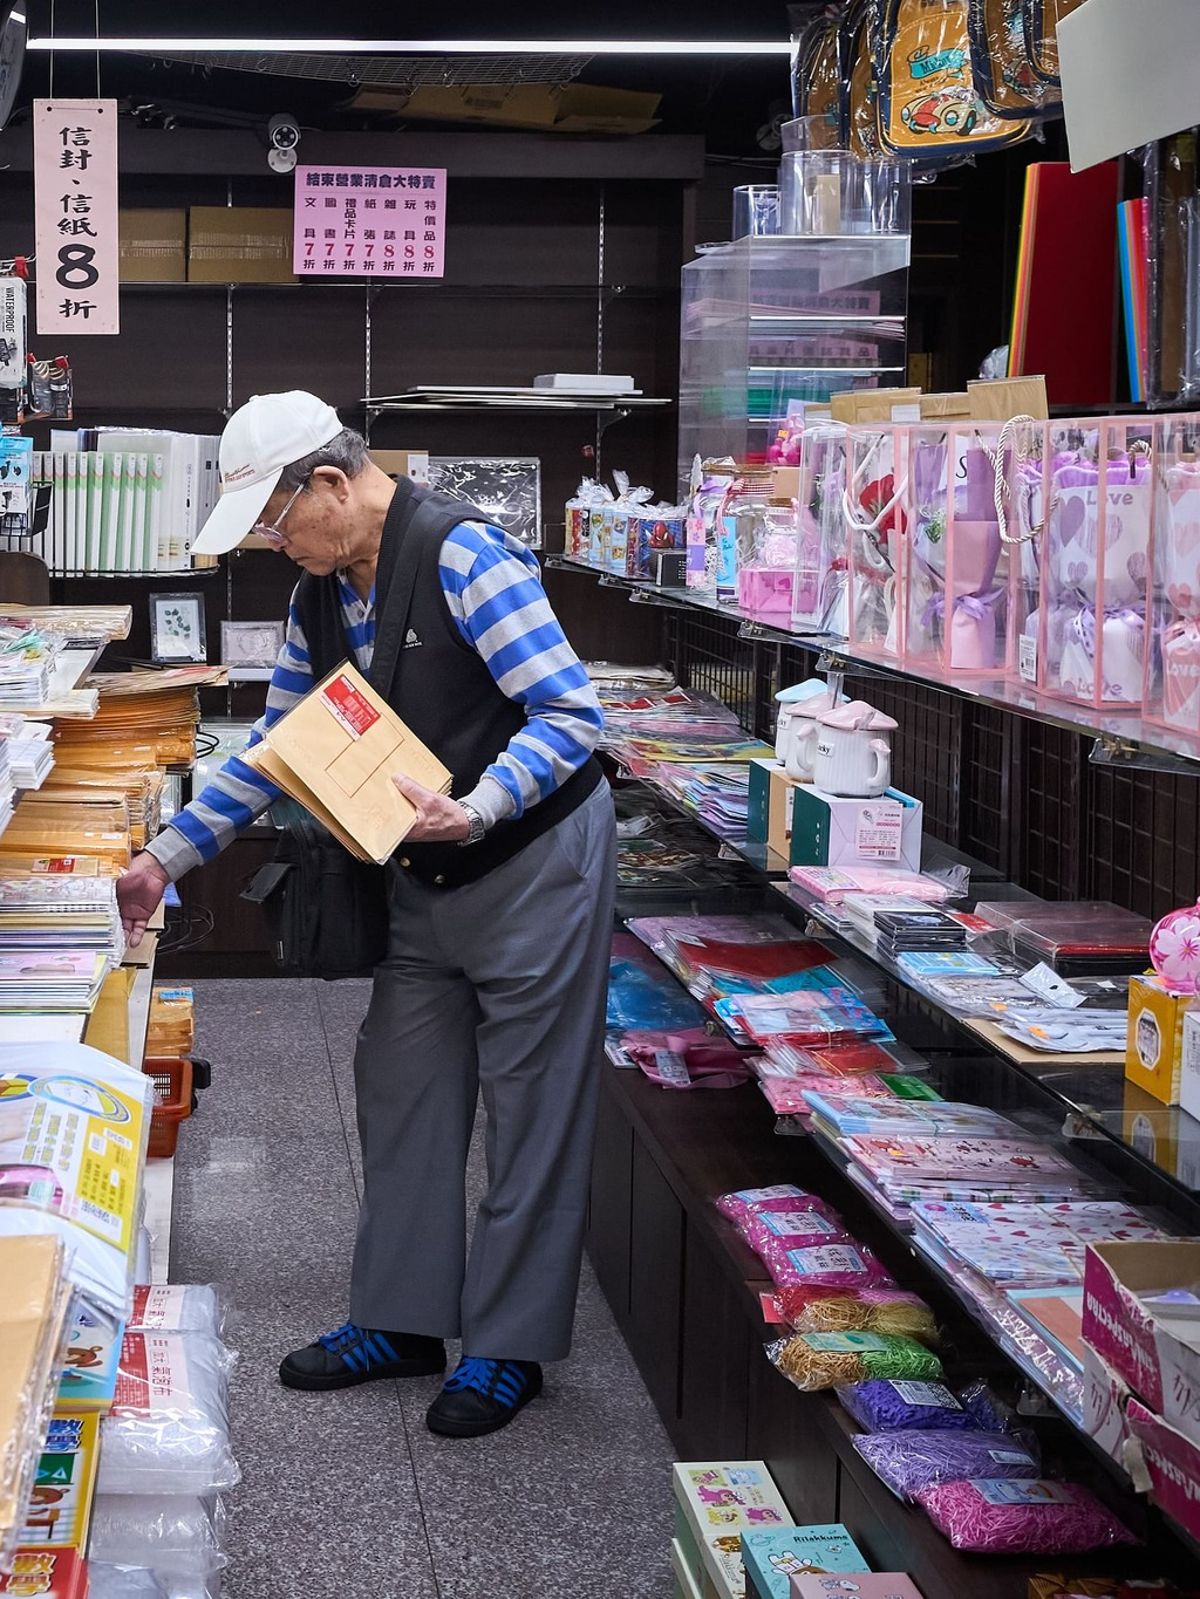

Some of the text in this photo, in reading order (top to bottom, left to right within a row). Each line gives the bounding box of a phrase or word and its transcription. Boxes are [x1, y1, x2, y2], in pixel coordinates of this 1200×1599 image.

[306, 172, 436, 190] 結束營業清倉大特賣
[56, 127, 101, 319] 信封、信紙8折
[6, 287, 14, 333] WATERPROOF
[1087, 490, 1134, 506] Lve
